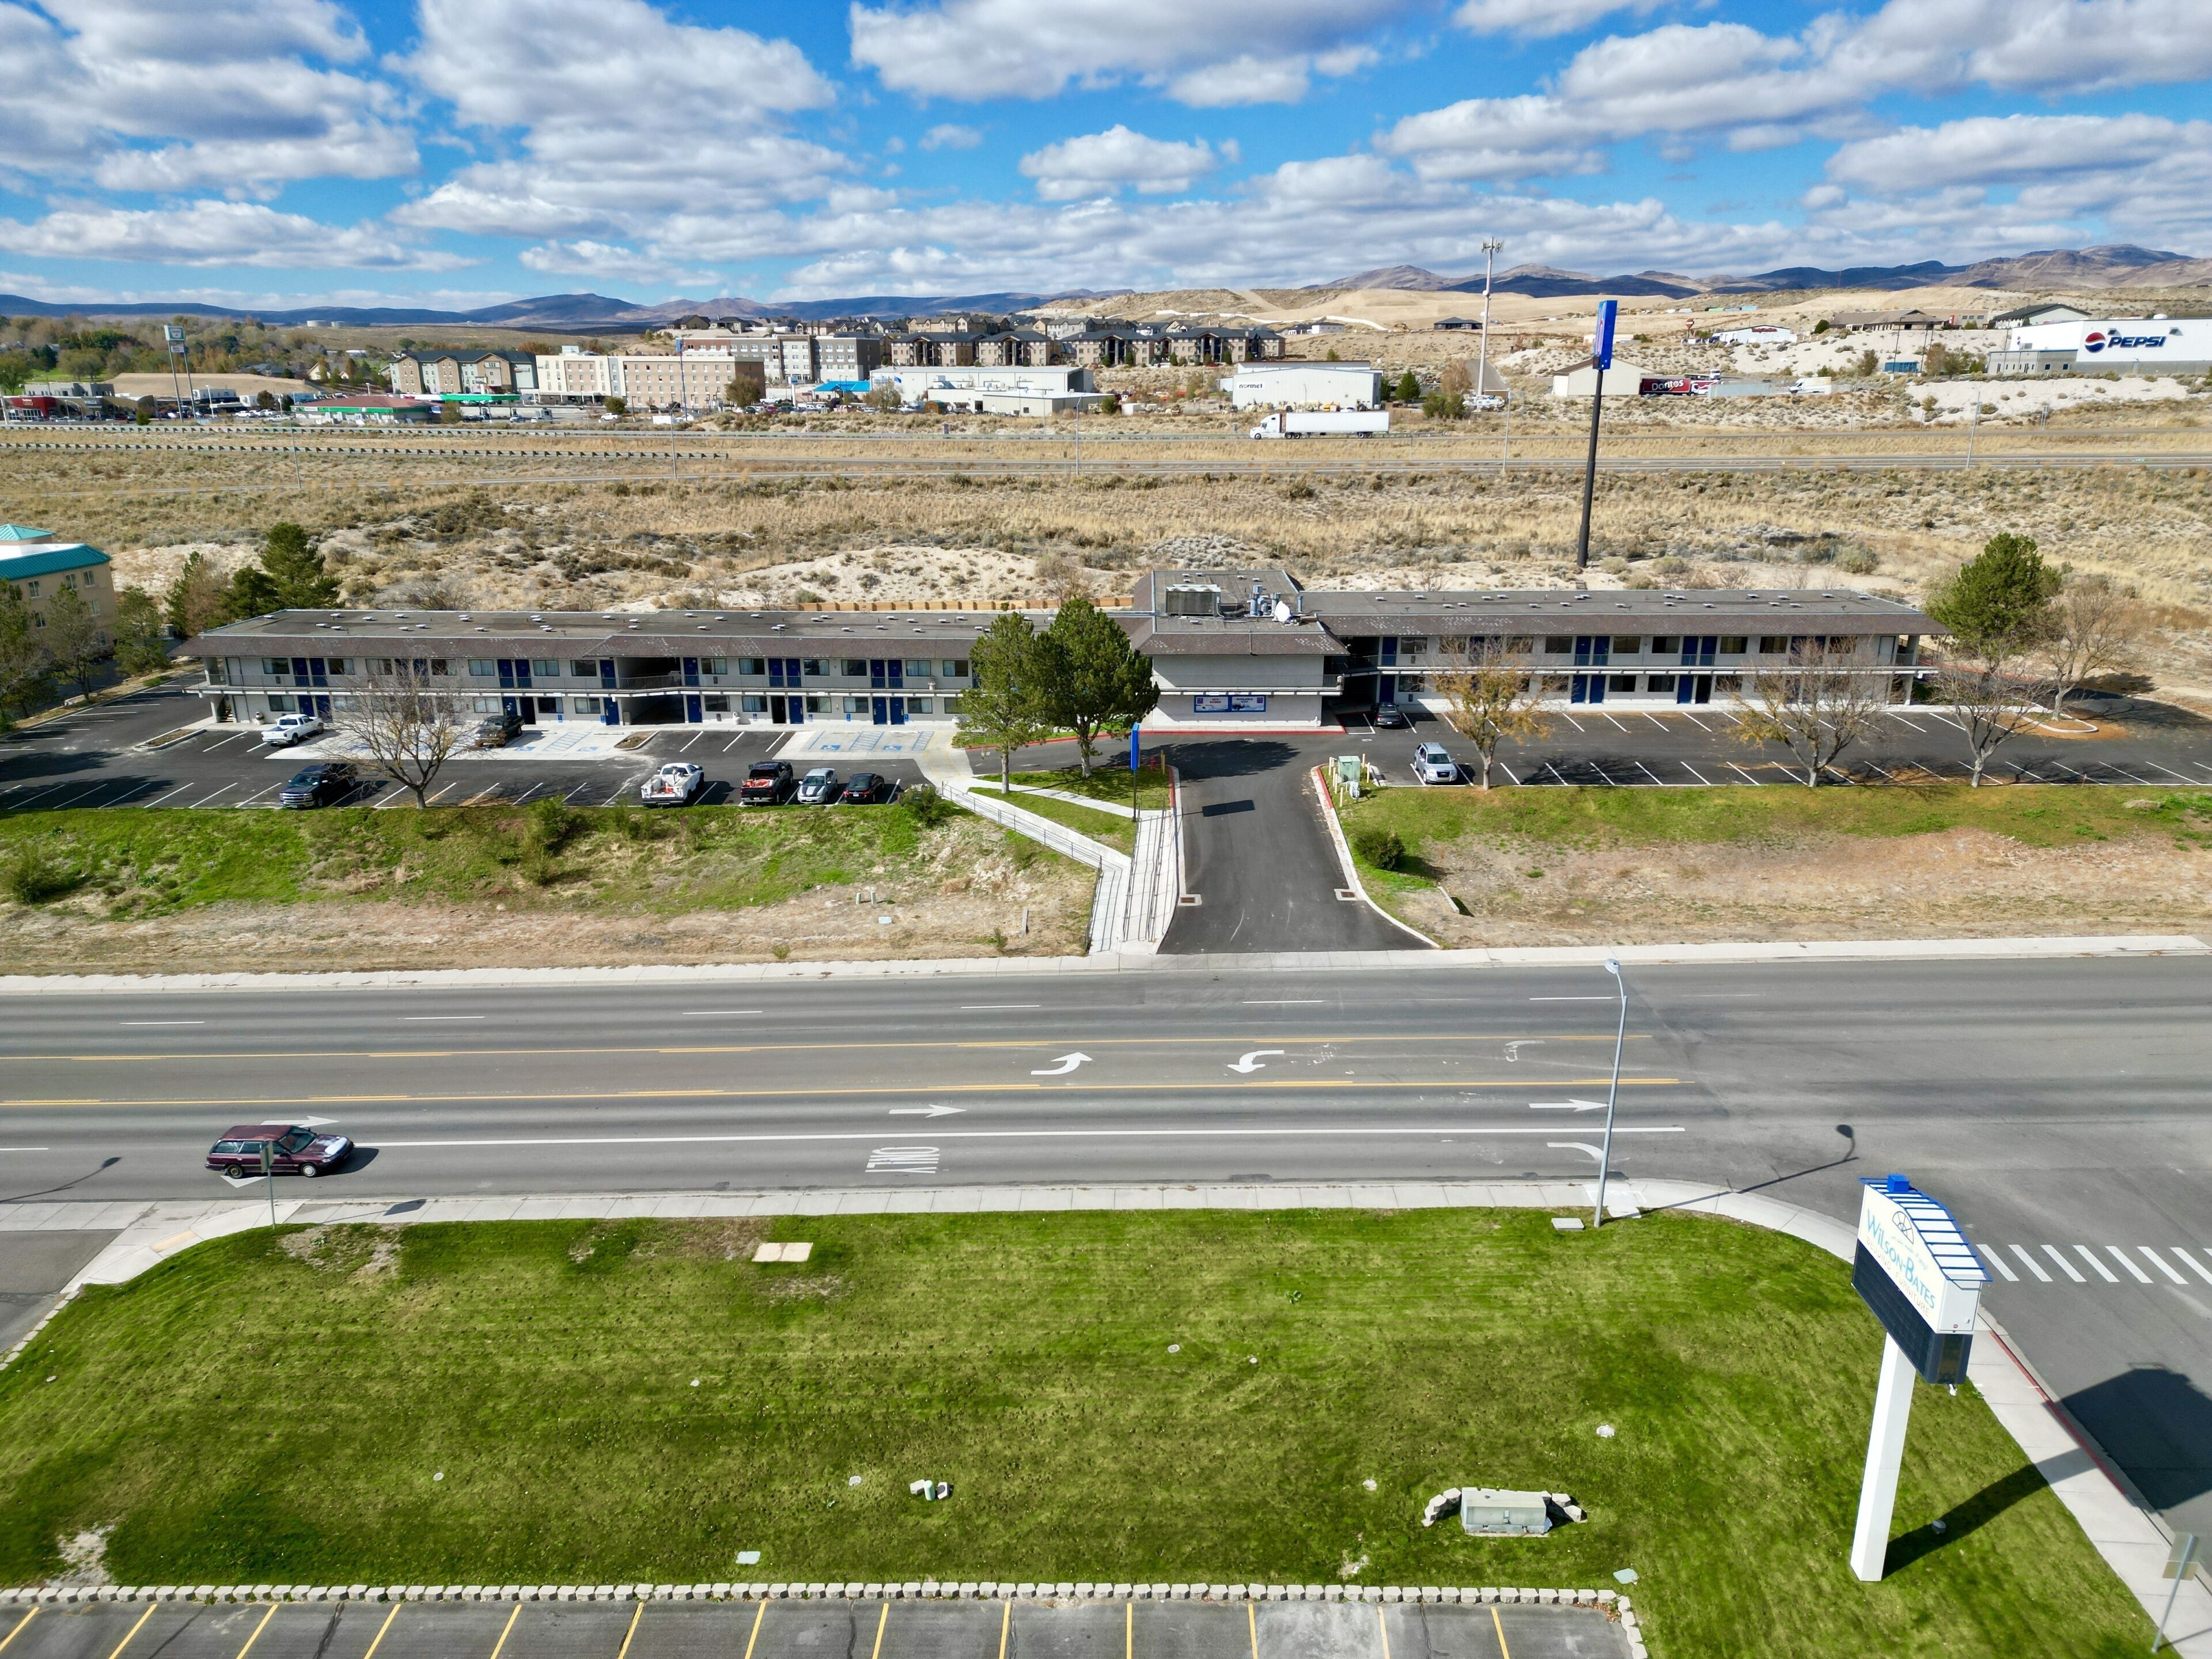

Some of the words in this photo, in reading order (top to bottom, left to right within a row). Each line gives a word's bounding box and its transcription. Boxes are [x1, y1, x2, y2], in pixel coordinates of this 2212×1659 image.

[2107, 335, 2167, 348] PEPSI
[1652, 380, 1684, 391] Doritos
[1895, 1271, 1930, 1317] FURNITURE
